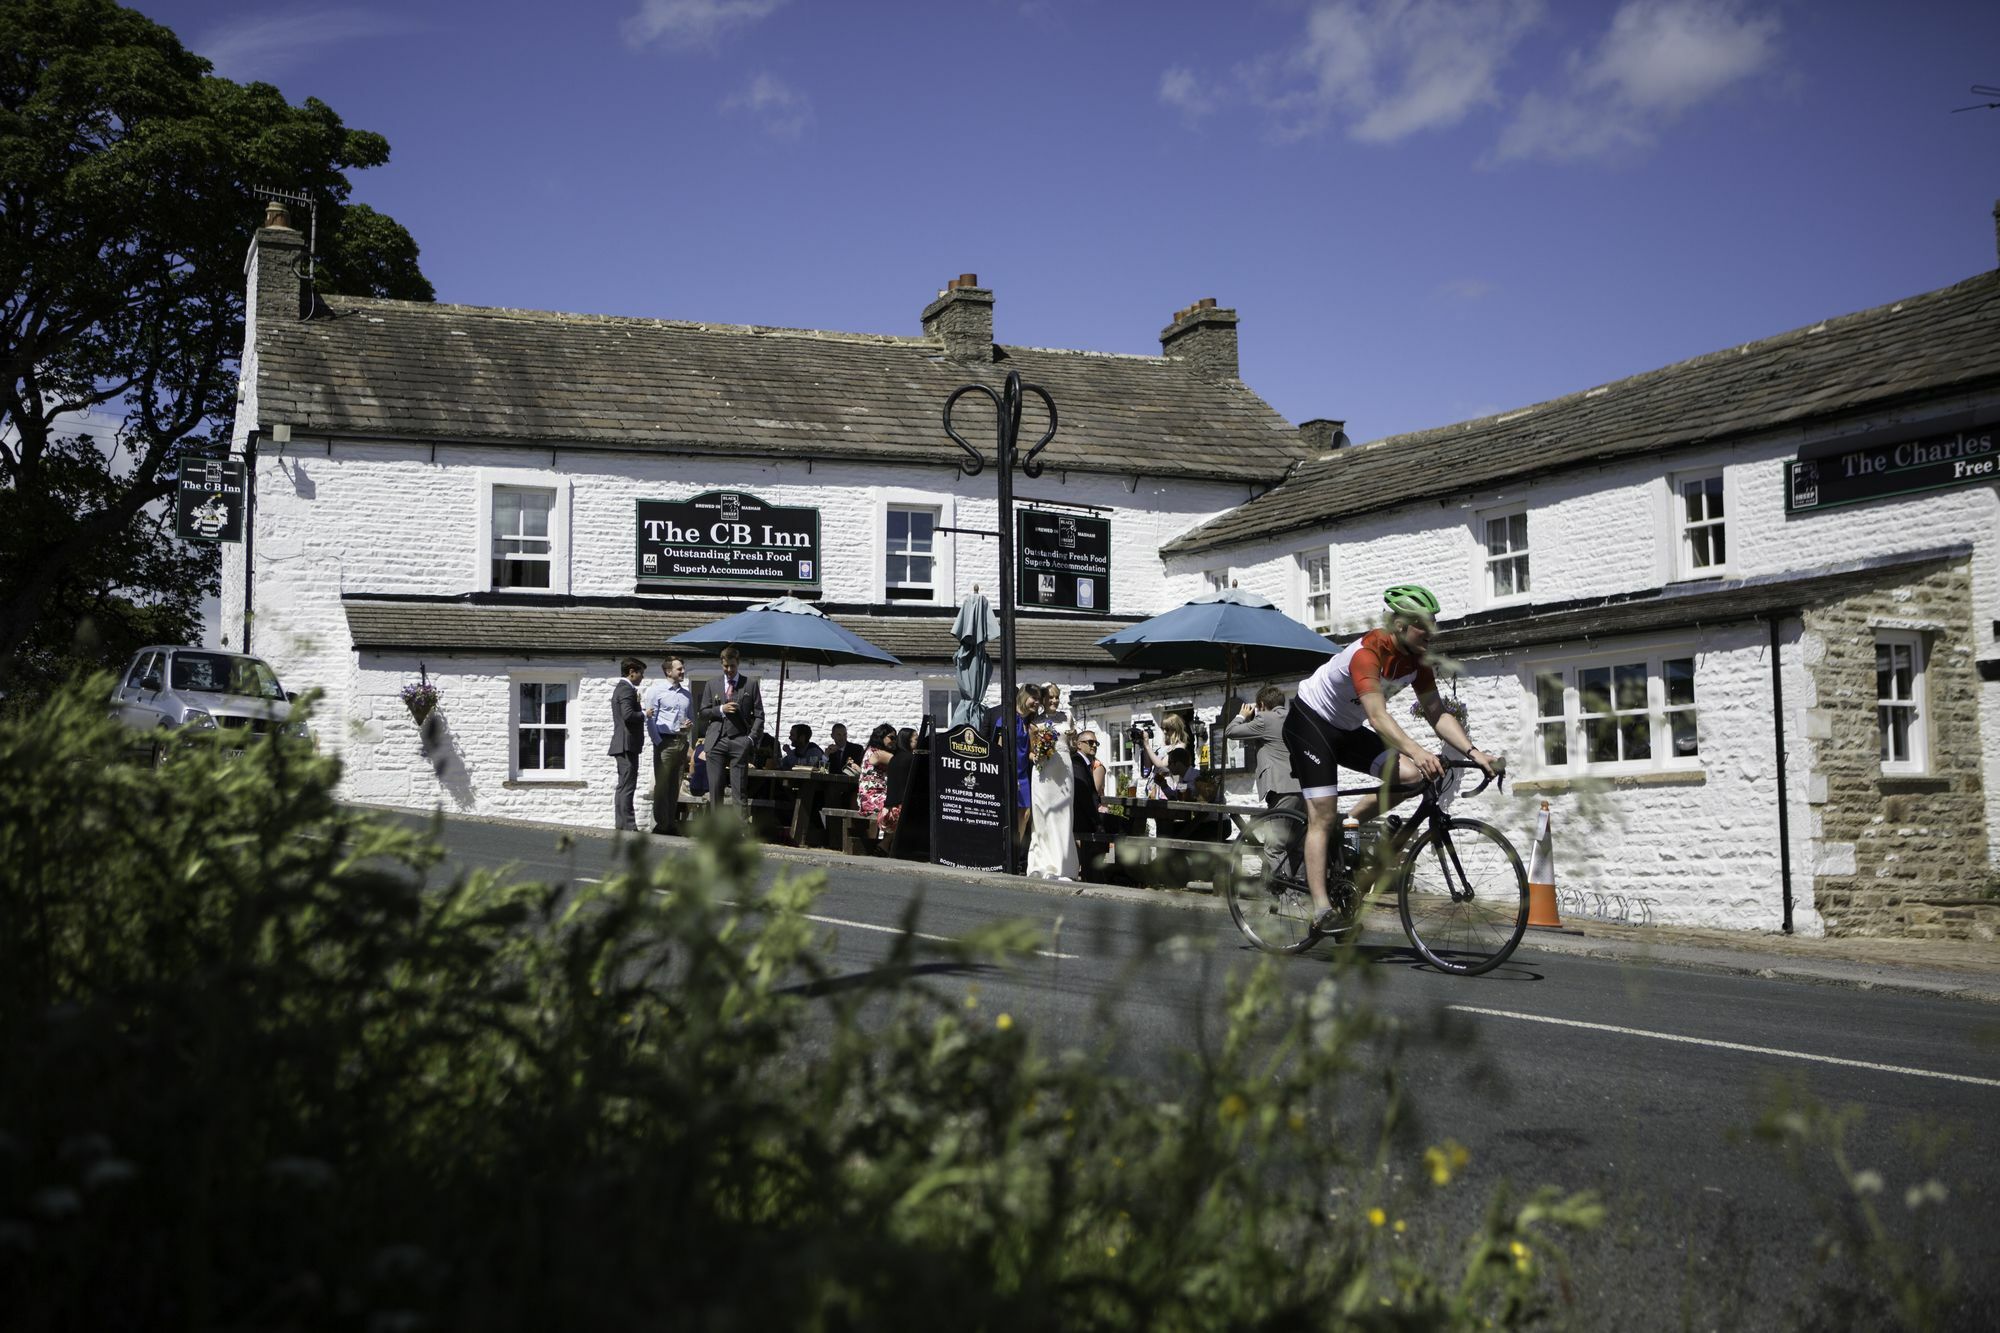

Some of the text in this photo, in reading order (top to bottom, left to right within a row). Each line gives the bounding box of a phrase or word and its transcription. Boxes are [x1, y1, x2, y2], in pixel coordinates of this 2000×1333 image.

[1842, 433, 1992, 478] The Charles
[1953, 461, 1993, 478] Free
[182, 480, 201, 490] The
[204, 482, 212, 490] C
[224, 484, 241, 492] Inn
[644, 520, 811, 547] The CB Inn
[664, 548, 792, 562] Outstanding Fresh Food
[1024, 547, 1106, 563] Outstanding Fresh Food
[673, 564, 783, 576] Superb Accommodation
[1025, 558, 1106, 573] Superb Accommodation
[1042, 576, 1054, 588] AA
[952, 742, 987, 754] THEAKSTON
[941, 757, 999, 775] THE CB INN
[940, 795, 973, 803] OUTSTANDING
